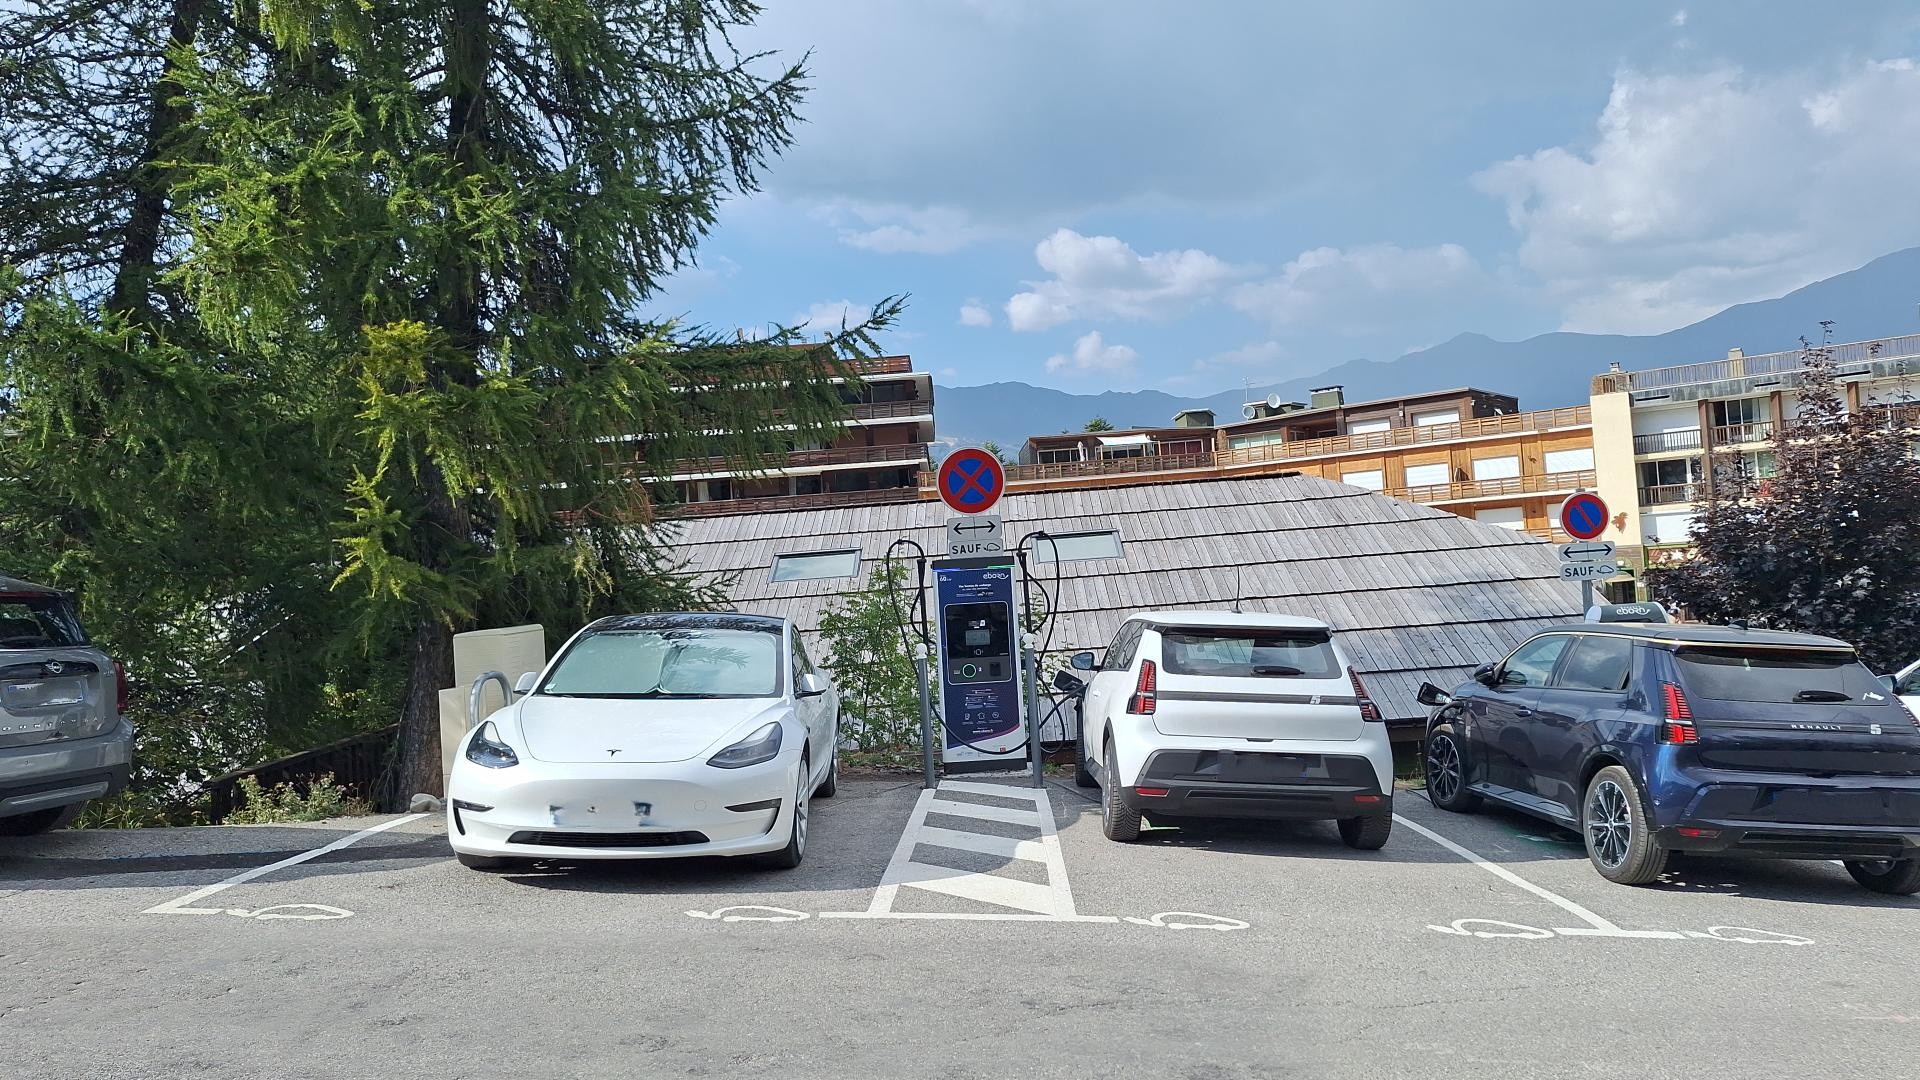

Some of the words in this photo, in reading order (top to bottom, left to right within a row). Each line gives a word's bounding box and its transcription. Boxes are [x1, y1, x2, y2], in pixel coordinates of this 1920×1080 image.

[952, 543, 982, 554] SAUF
[1564, 566, 1594, 577] SAUF
[1790, 723, 1842, 731] RENAULT
[1870, 723, 1882, 735] 5
